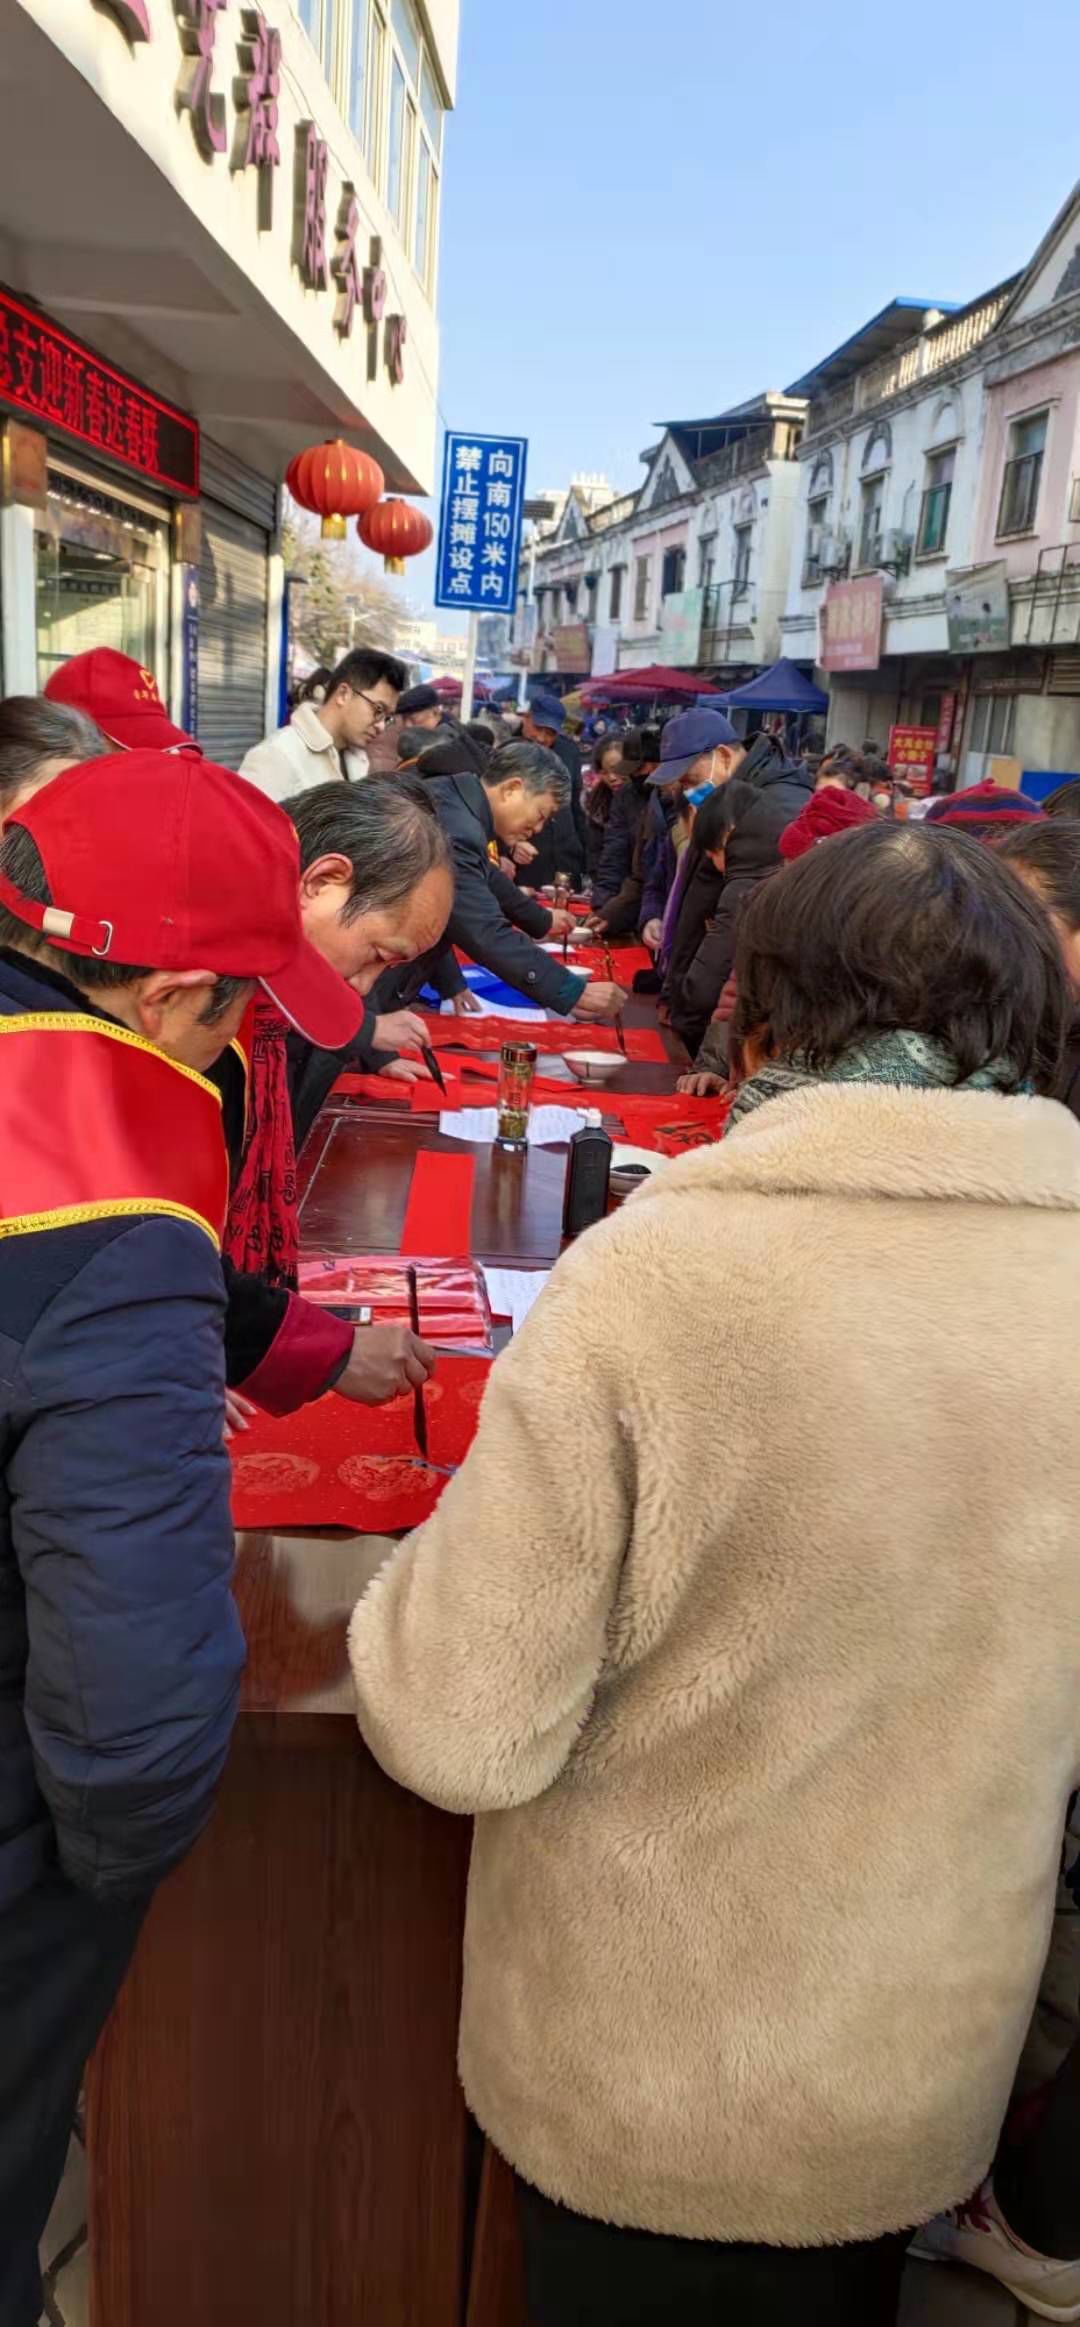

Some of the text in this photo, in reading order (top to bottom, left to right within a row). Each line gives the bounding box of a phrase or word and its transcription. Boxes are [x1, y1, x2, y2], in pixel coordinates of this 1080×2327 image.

[447, 445, 482, 595] 禁止摆摊设点
[481, 449, 514, 598] 向南150米内
